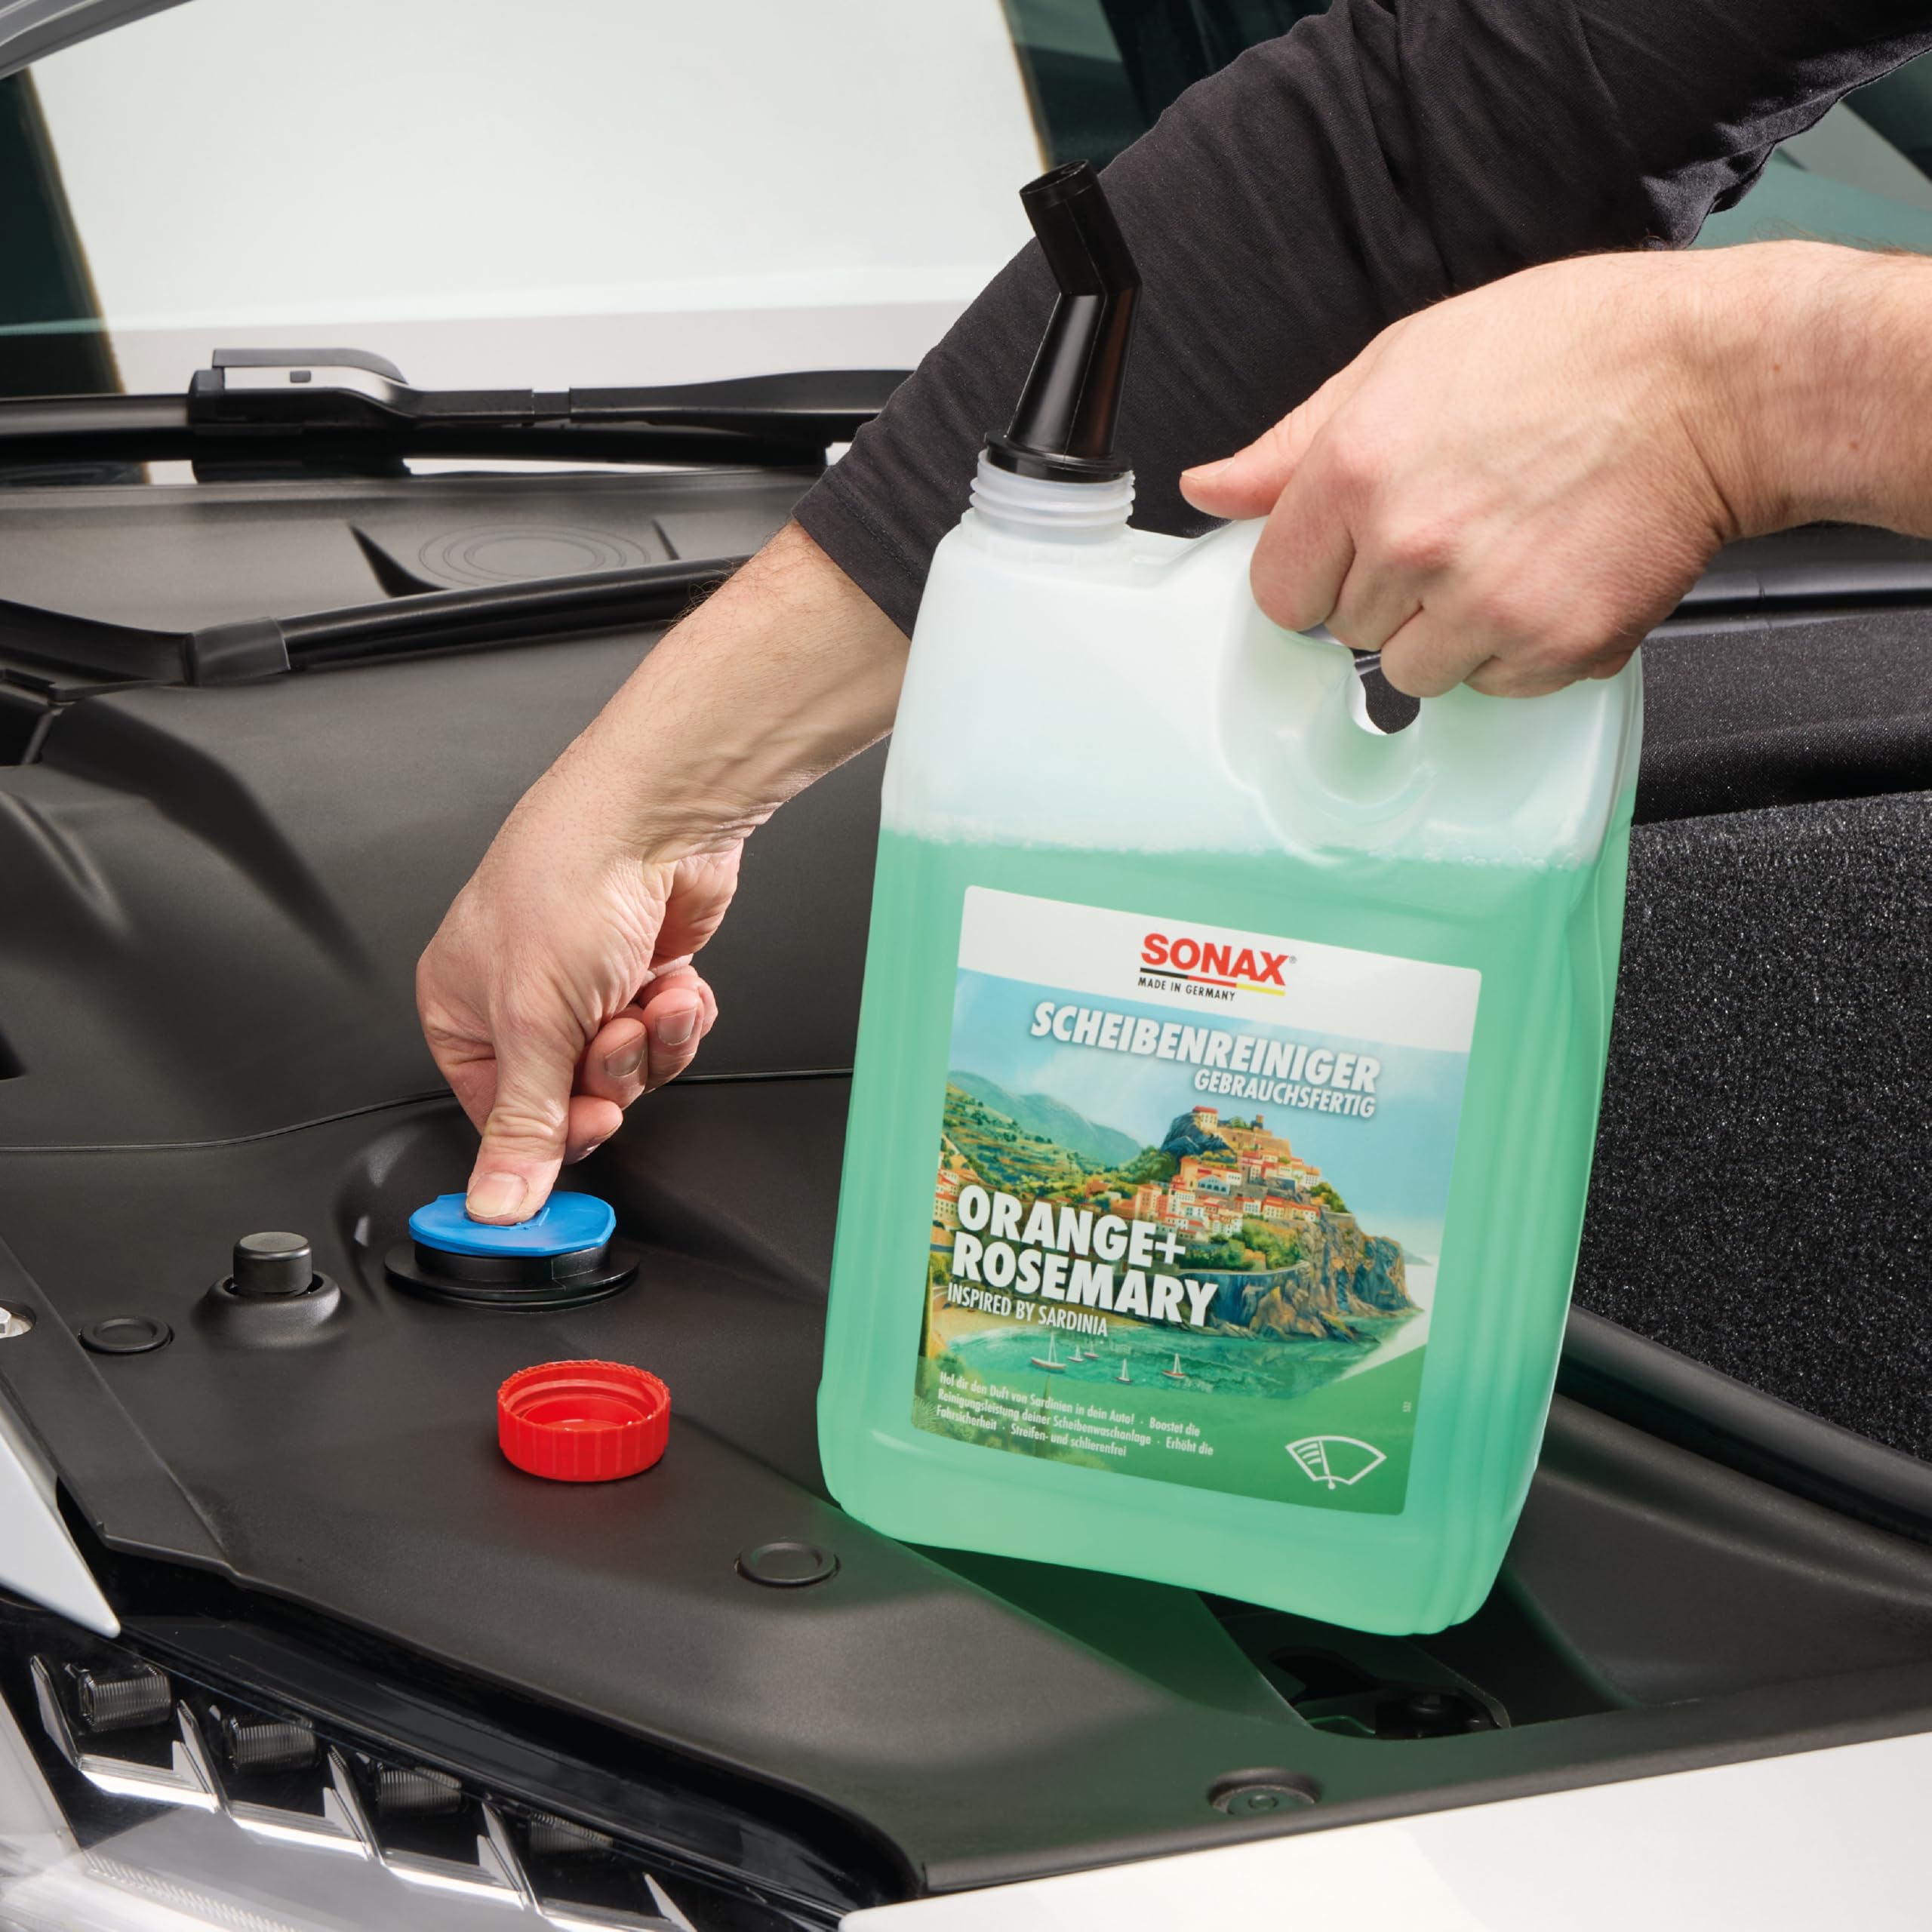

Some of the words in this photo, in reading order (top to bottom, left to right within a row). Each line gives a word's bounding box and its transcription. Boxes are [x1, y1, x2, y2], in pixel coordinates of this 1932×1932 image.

[1138, 977, 1166, 991] MADE
[1171, 981, 1181, 993] IN
[1186, 983, 1235, 1001] GERMANY
[1141, 933, 1288, 986] SONAX
[1030, 1001, 1380, 1094] SCHEIBENREINIGER
[1194, 1069, 1376, 1118] GEBRAUCHSFERTIG
[957, 1185, 1186, 1268] ORANGE+
[947, 1281, 1011, 1317] INSPIRED
[1015, 1299, 1033, 1322] BY
[1038, 1305, 1108, 1337] SARDINIA
[952, 1232, 1219, 1327] ROSEMARY
[936, 1404, 997, 1430] Fahrsicherheit
[1011, 1423, 1049, 1441] Streifen-
[1051, 1433, 1068, 1445] und
[1071, 1435, 1127, 1457] schlierenfrei
[937, 1388, 1020, 1421] Reinigungsleistung
[1022, 1408, 1051, 1425] deiner
[1053, 1414, 1151, 1446] Scheibenwaschanlage
[1166, 1436, 1196, 1453] Erhöht
[1198, 1441, 1214, 1456] die
[940, 1371, 955, 1386] Hol
[956, 1376, 968, 1389] dir
[971, 1380, 986, 1395] den
[989, 1384, 1009, 1399] Duft
[1011, 1392, 1027, 1404] von
[1030, 1394, 1072, 1413] Sardinien
[1075, 1404, 1084, 1415] in
[1087, 1404, 1107, 1420] dein
[1109, 1409, 1134, 1425] Auto!
[1149, 1417, 1183, 1435] Boostet
[1185, 1422, 1200, 1437] die
